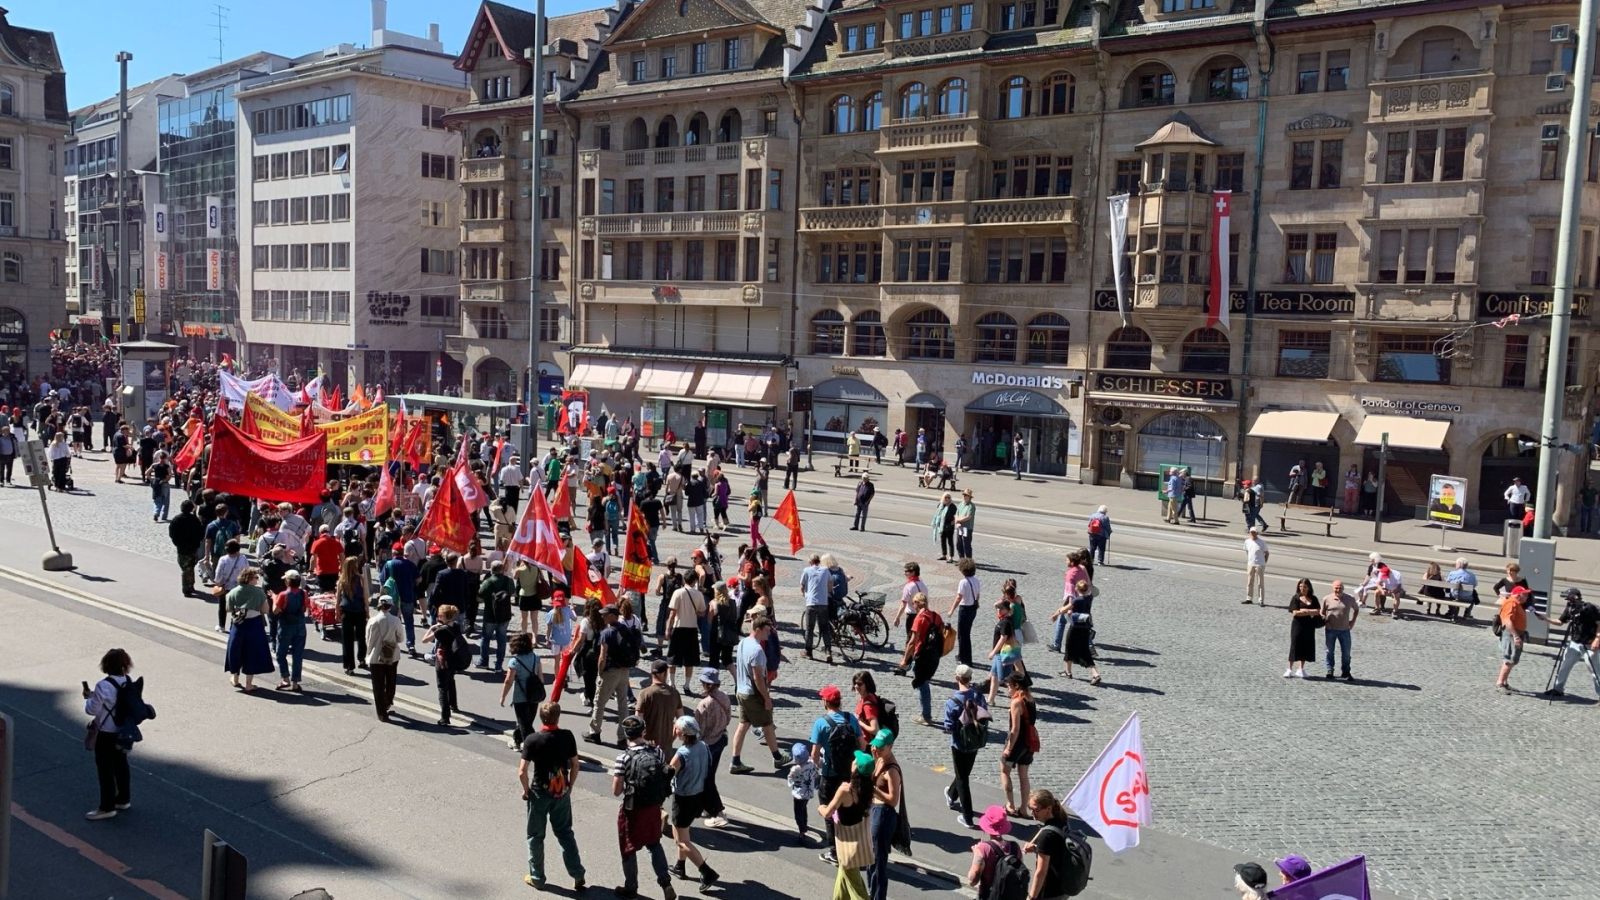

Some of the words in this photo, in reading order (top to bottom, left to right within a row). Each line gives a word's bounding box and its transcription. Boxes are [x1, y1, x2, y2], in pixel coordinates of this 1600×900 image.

[210, 250, 219, 266] city
[367, 291, 410, 307] flying
[1259, 292, 1354, 311] Tea-Room
[370, 304, 407, 319] tiger
[972, 371, 1063, 389] McDonald's
[1102, 377, 1225, 397] SCHIESSER
[1360, 398, 1403, 409] Davidoff
[1405, 401, 1415, 409] of
[1418, 401, 1461, 412] Geneva
